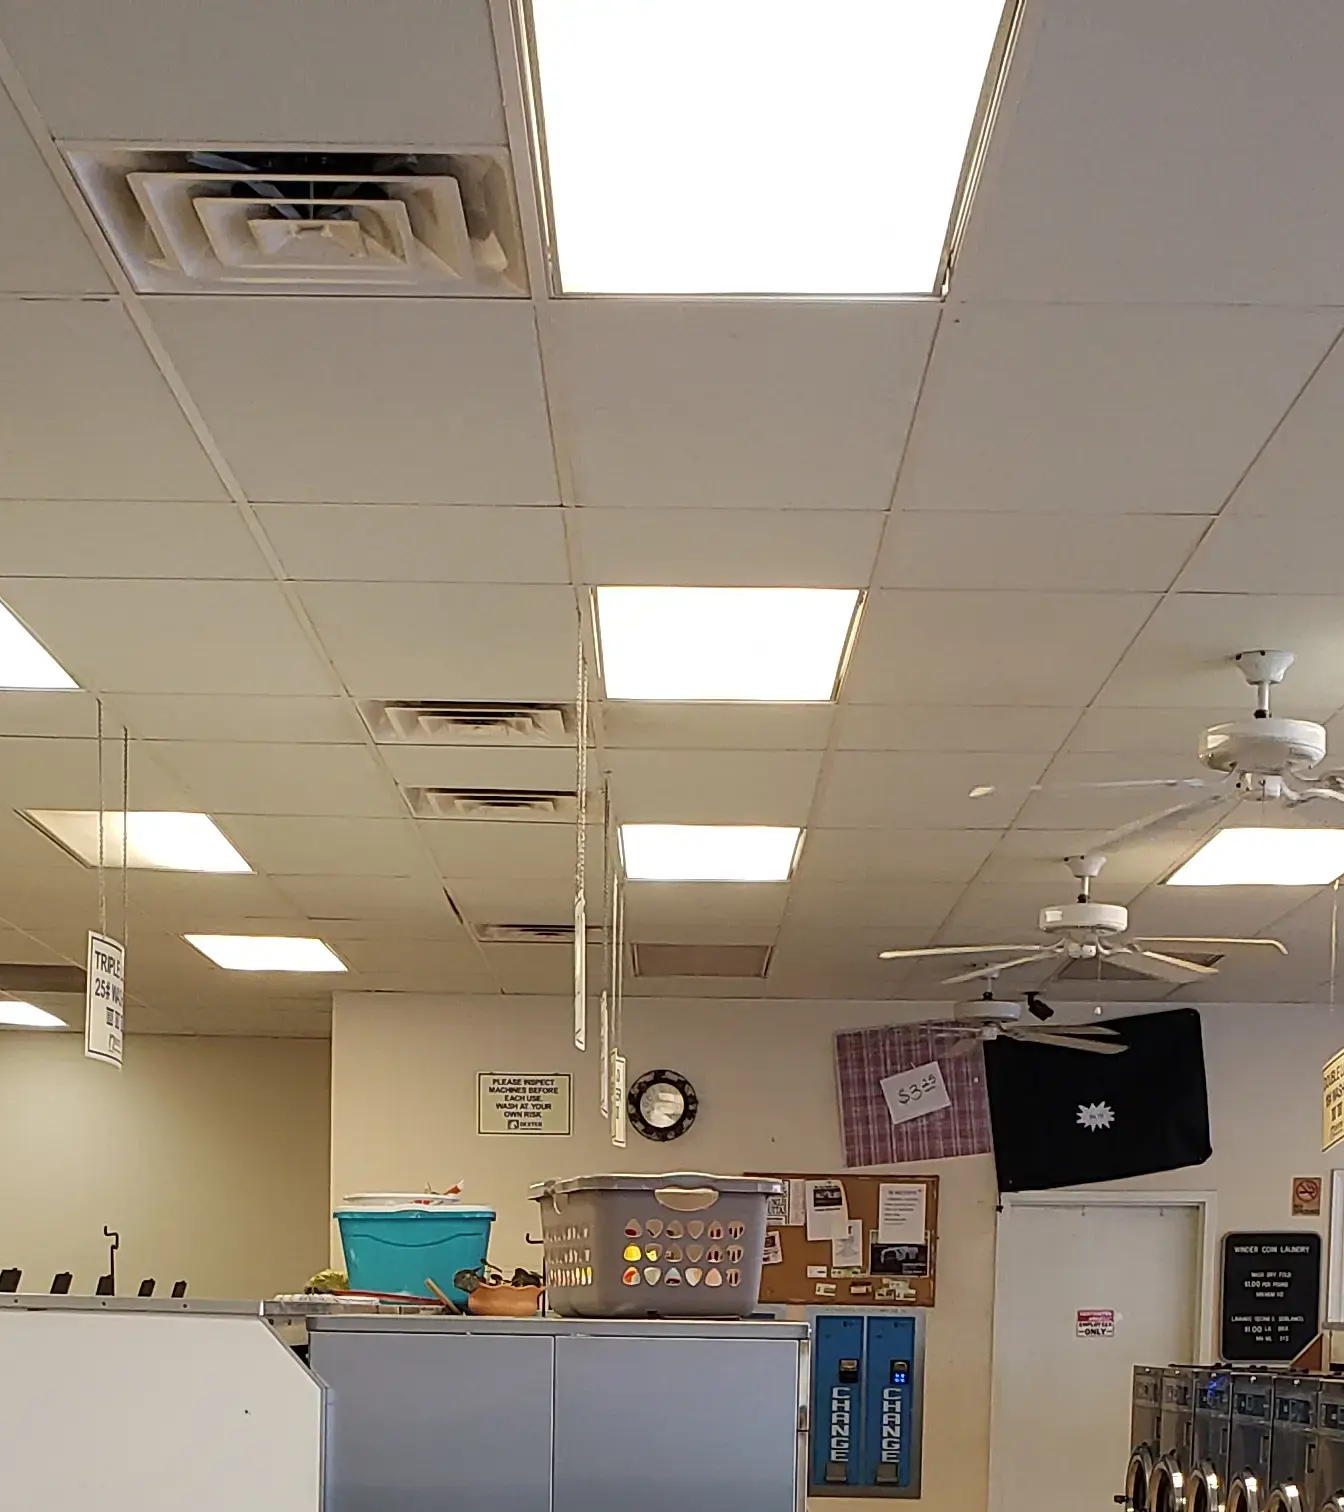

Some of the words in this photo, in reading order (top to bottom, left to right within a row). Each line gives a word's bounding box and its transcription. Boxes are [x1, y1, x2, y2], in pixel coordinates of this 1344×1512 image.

[95, 950, 121, 979] TRIPLE
[95, 978, 110, 1000] 25#
[488, 1086, 527, 1094] MACHINES
[492, 1078, 522, 1086] PLEASE
[1234, 1245, 1259, 1253] WINDER
[1261, 1245, 1278, 1253] COIN
[1280, 1245, 1310, 1253] LAUNDRY
[830, 1387, 851, 1462] CHANGE
[881, 1387, 903, 1463] CHANGE
